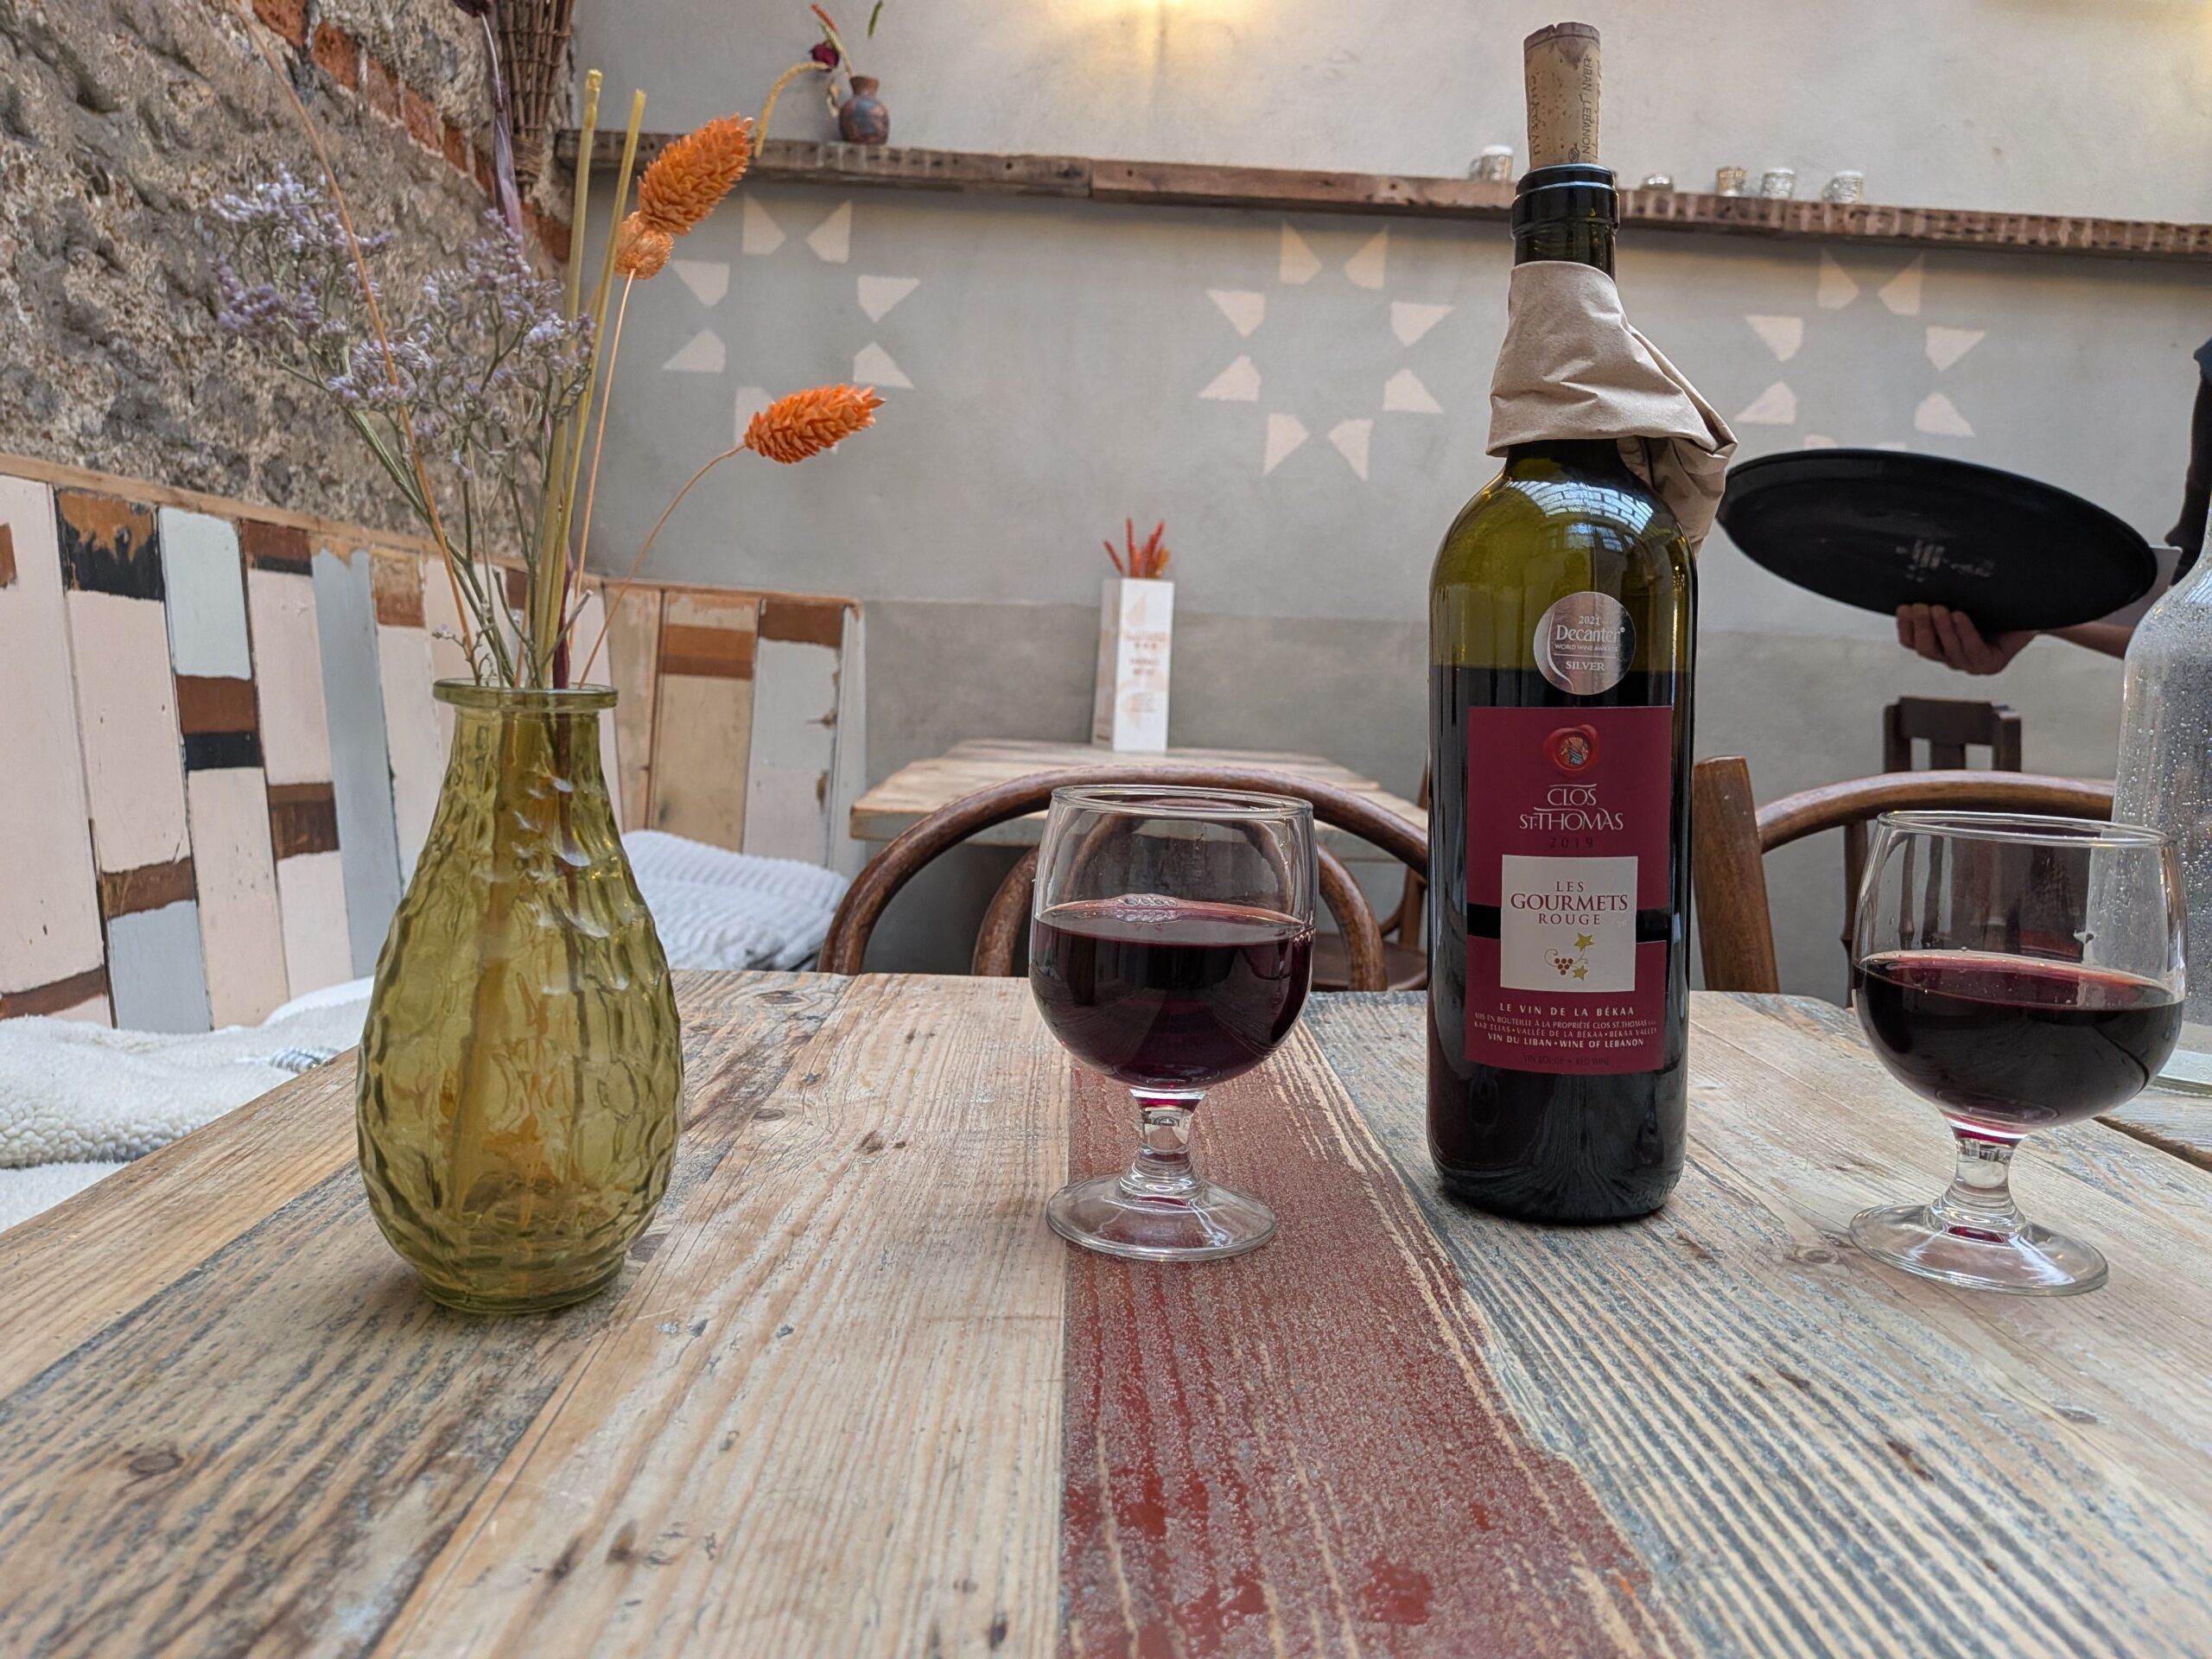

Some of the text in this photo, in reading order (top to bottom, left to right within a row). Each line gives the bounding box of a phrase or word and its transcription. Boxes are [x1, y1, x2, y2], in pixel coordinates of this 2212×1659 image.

[1581, 93, 1592, 154] LEBANON
[1578, 615, 1601, 625] 2021
[1555, 624, 1621, 643] Decanter
[1565, 660, 1605, 671] SILVER
[1547, 787, 1597, 807] CLOS
[1549, 836, 1594, 849] 2019
[1556, 881, 1584, 893] LES
[1510, 893, 1629, 912] GOURMETS
[1538, 913, 1601, 925] ROUGE
[1499, 1002, 1512, 1012] LE
[1519, 1005, 1541, 1015] VIN
[1550, 1007, 1566, 1016] DE
[1574, 1007, 1588, 1016] LA
[1497, 1015, 1532, 1027] BOUTEILLE
[1487, 1033, 1503, 1042] VIN
[1506, 1035, 1520, 1044] DU
[1523, 1038, 1552, 1047] LIBAN
[1559, 1039, 1585, 1048] WINE
[1605, 1038, 1644, 1048] LEBANON
